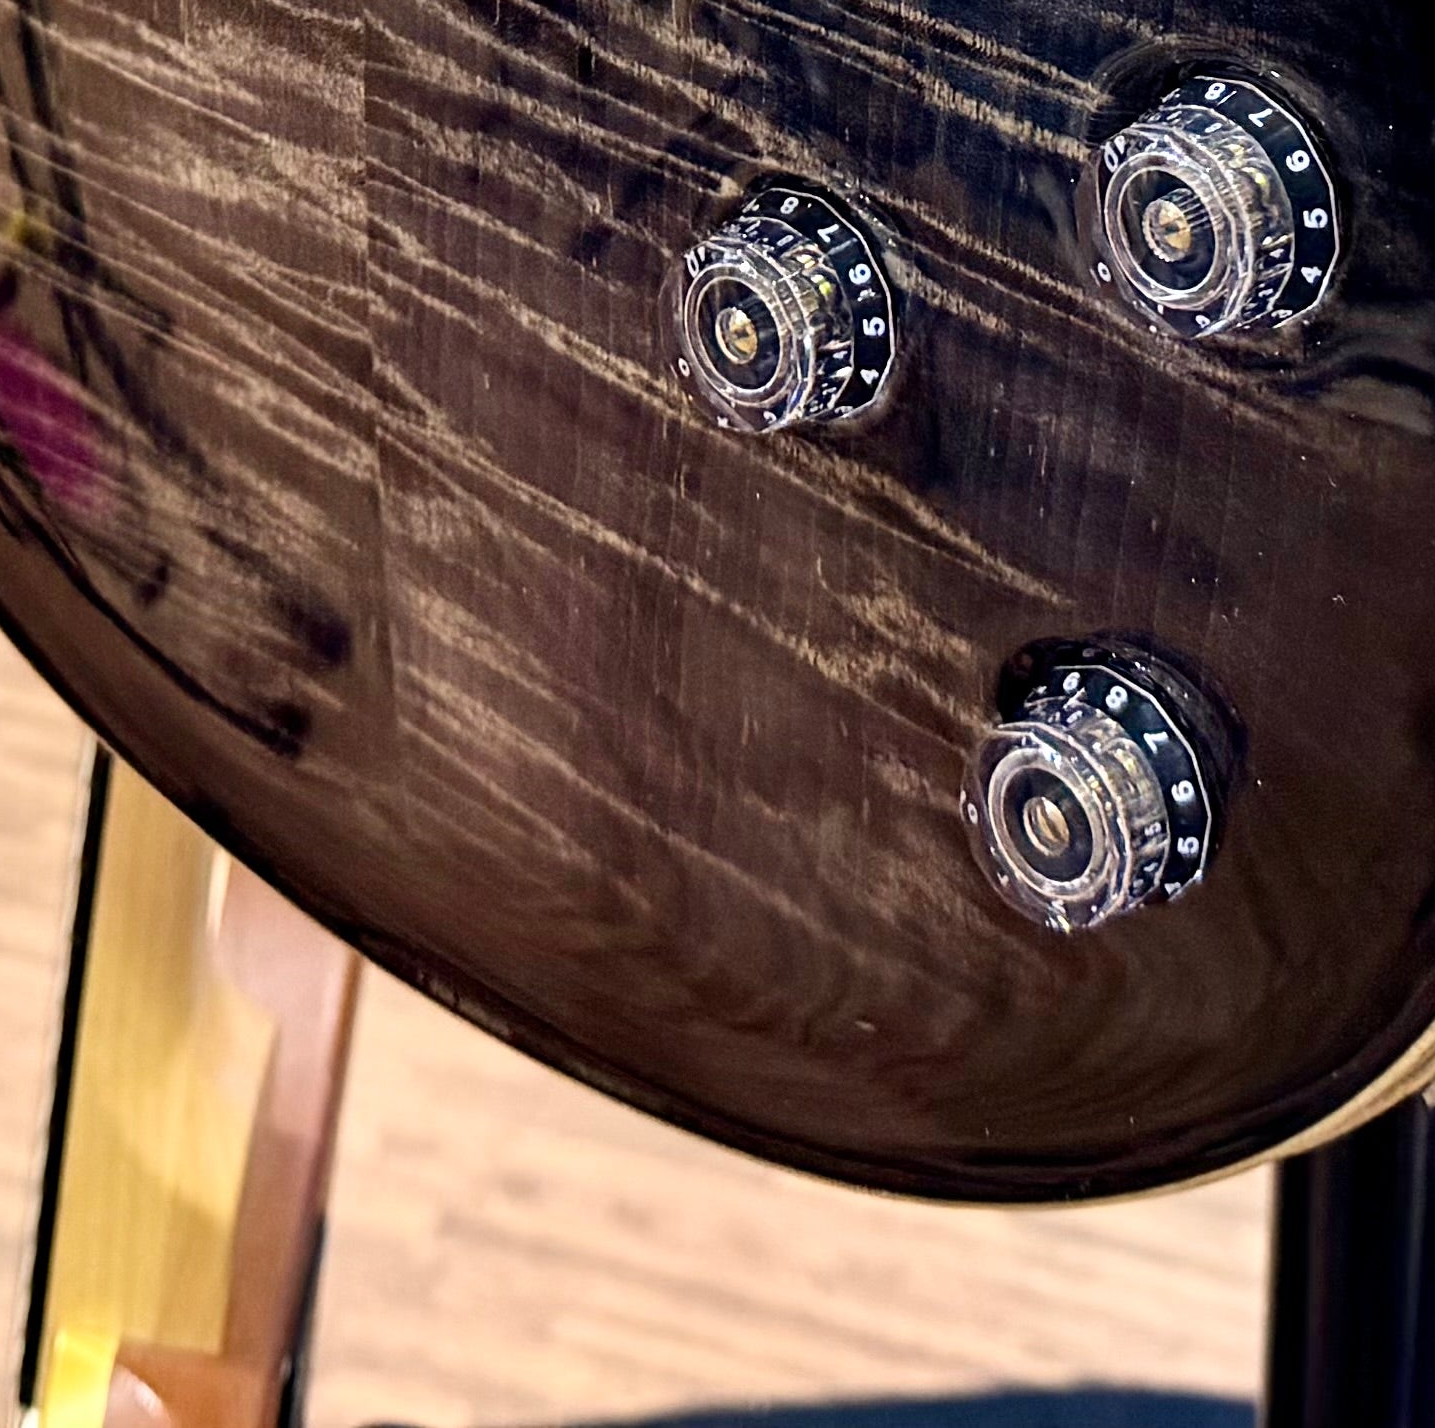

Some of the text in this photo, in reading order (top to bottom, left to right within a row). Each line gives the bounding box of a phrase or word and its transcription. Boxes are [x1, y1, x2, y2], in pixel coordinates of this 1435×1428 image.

[1204, 81, 1226, 100] 8
[1248, 107, 1272, 127] 7
[1285, 148, 1310, 172] 6
[780, 196, 799, 214] 8
[1303, 207, 1328, 229] 5
[817, 223, 839, 242] 7
[848, 263, 872, 285] 6
[1300, 265, 1322, 284] 4
[862, 316, 886, 336] 5
[1105, 685, 1128, 710] 8
[1143, 731, 1169, 753] 7
[1171, 779, 1194, 802] 6
[1176, 835, 1200, 856] 5
